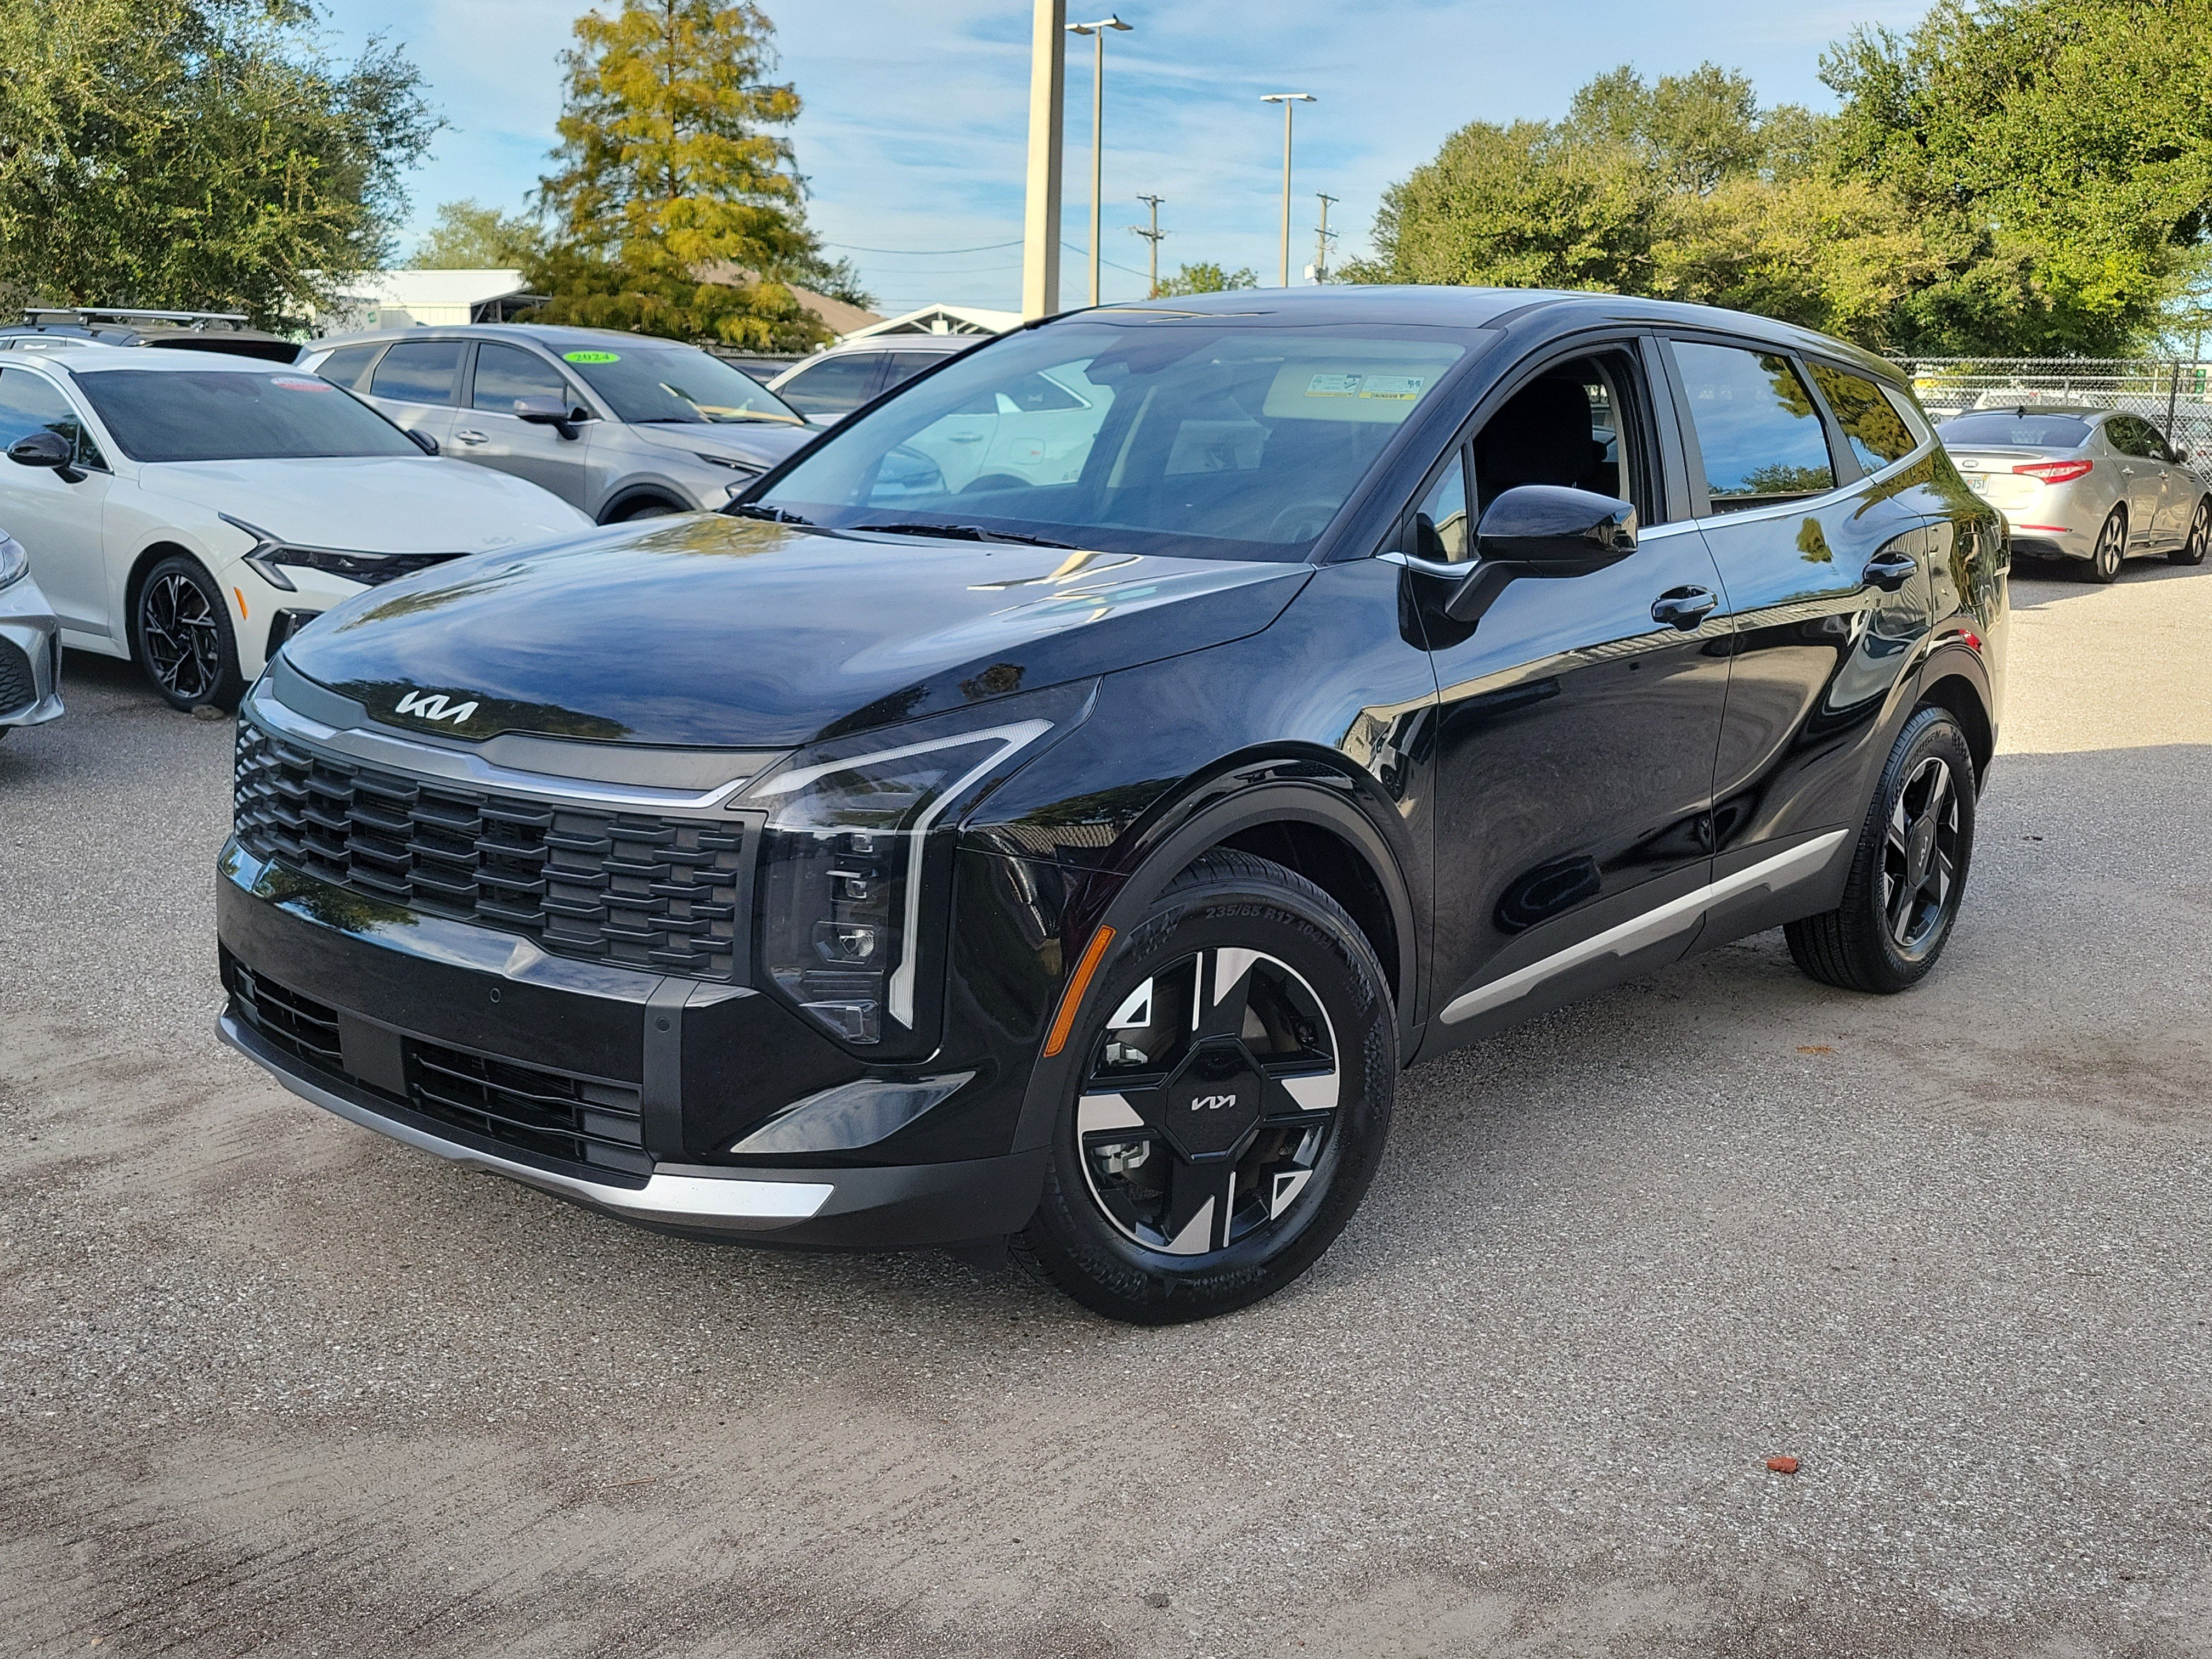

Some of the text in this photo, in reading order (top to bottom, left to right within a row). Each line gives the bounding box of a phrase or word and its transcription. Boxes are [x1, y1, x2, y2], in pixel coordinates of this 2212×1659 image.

[395, 690, 479, 725] KIA
[1206, 905, 1333, 950] 235/65 R17 104H
[1191, 1094, 1236, 1111] KIA
